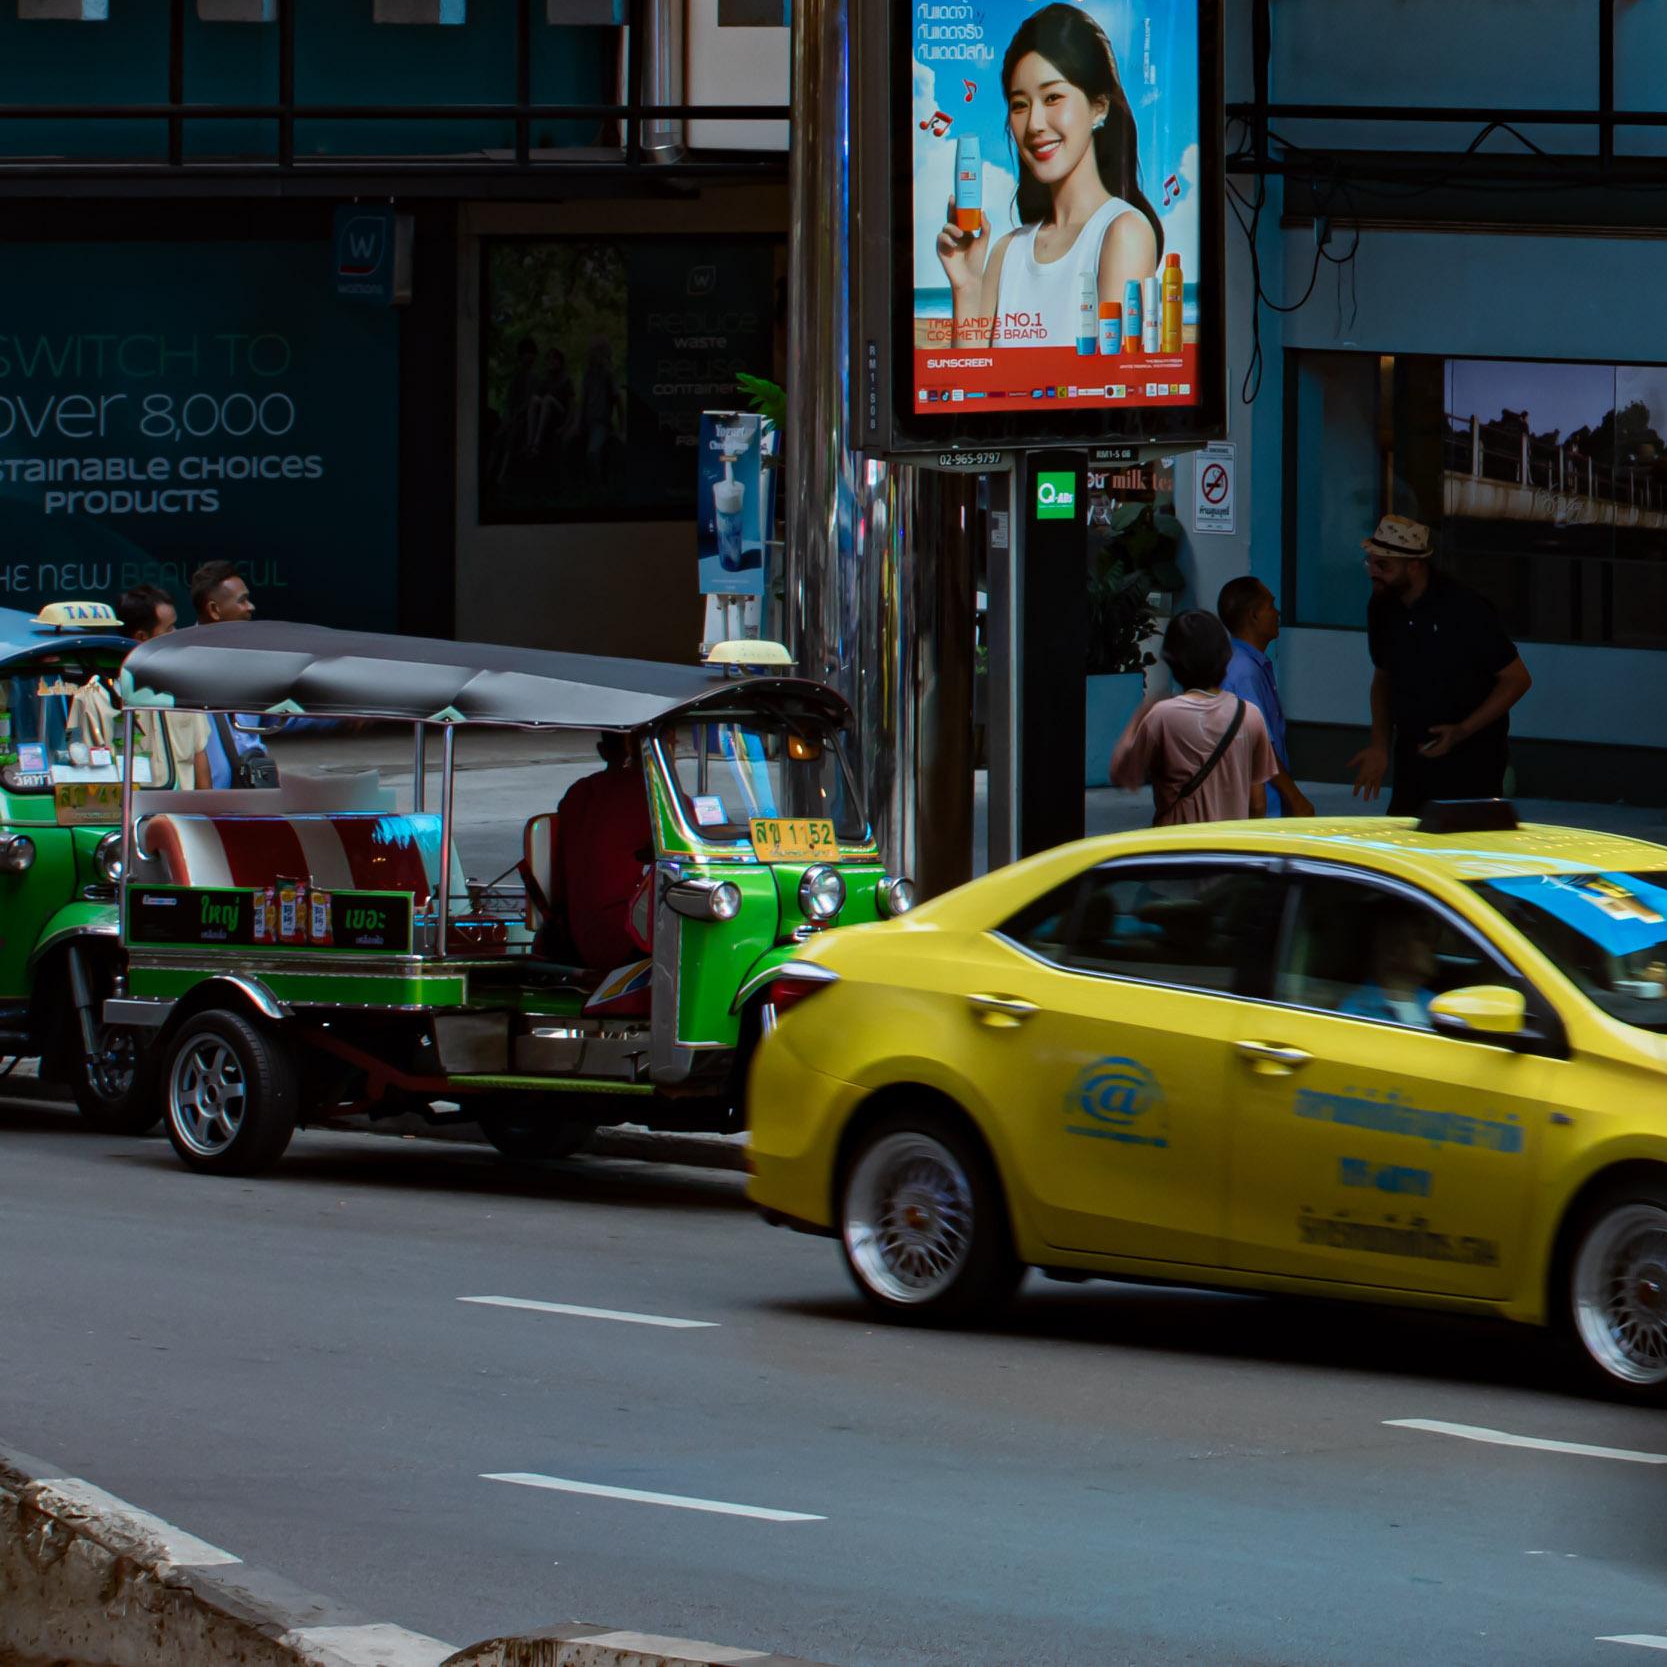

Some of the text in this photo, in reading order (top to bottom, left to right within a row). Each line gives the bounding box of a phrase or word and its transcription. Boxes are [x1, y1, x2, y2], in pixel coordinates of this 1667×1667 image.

[1005, 312, 1043, 328] NO.1
[926, 328, 1048, 342] COSMETICS BRAND
[214, 334, 292, 378] TO
[927, 358, 993, 369] SUNSCREEN
[139, 392, 296, 443] 8,000
[939, 452, 1001, 466] 02-965-9797
[1112, 468, 1147, 490] milk
[63, 604, 112, 620] TAXI
[200, 895, 240, 932] ใหญ่
[345, 908, 386, 930] เยอะ
